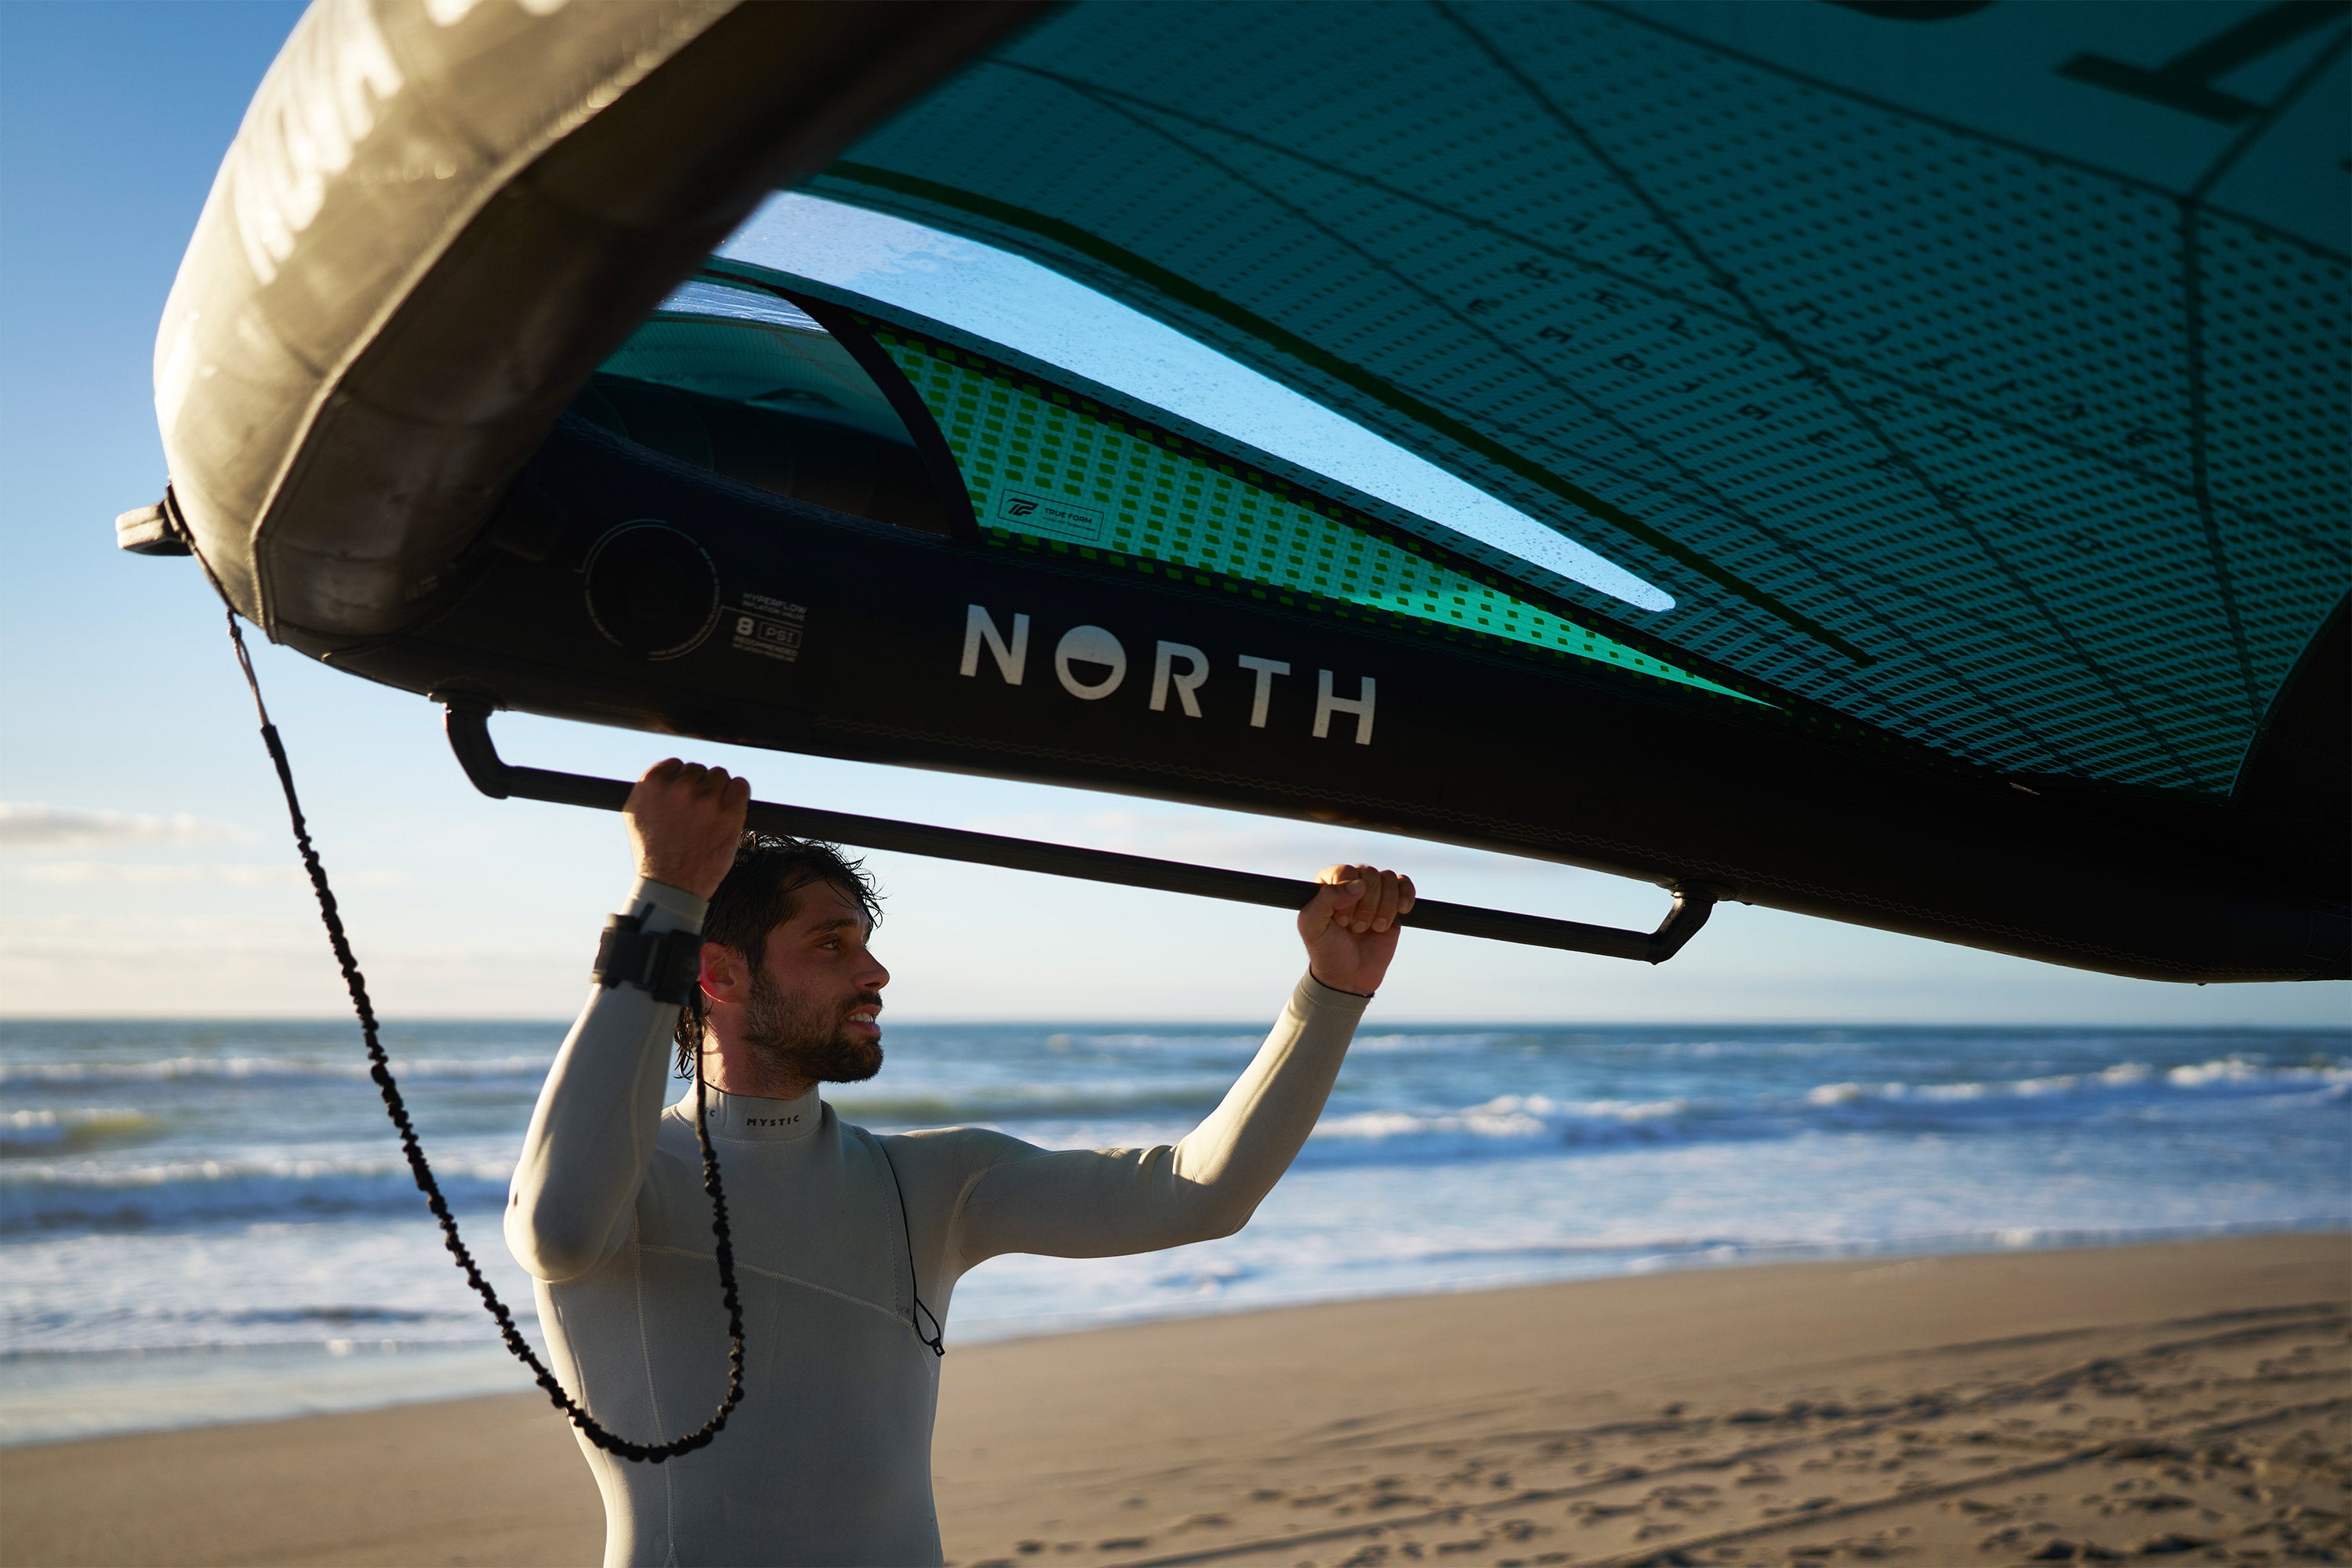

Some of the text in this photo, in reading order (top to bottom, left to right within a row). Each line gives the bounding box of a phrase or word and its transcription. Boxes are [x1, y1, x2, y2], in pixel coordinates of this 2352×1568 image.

[1044, 507, 1092, 524] TRUE FORM
[742, 591, 808, 613] HYPERFLOW
[735, 616, 755, 636] 8
[765, 626, 794, 643] PSI
[959, 603, 1376, 746] NORTH
[746, 1115, 800, 1127] MYSTIC
